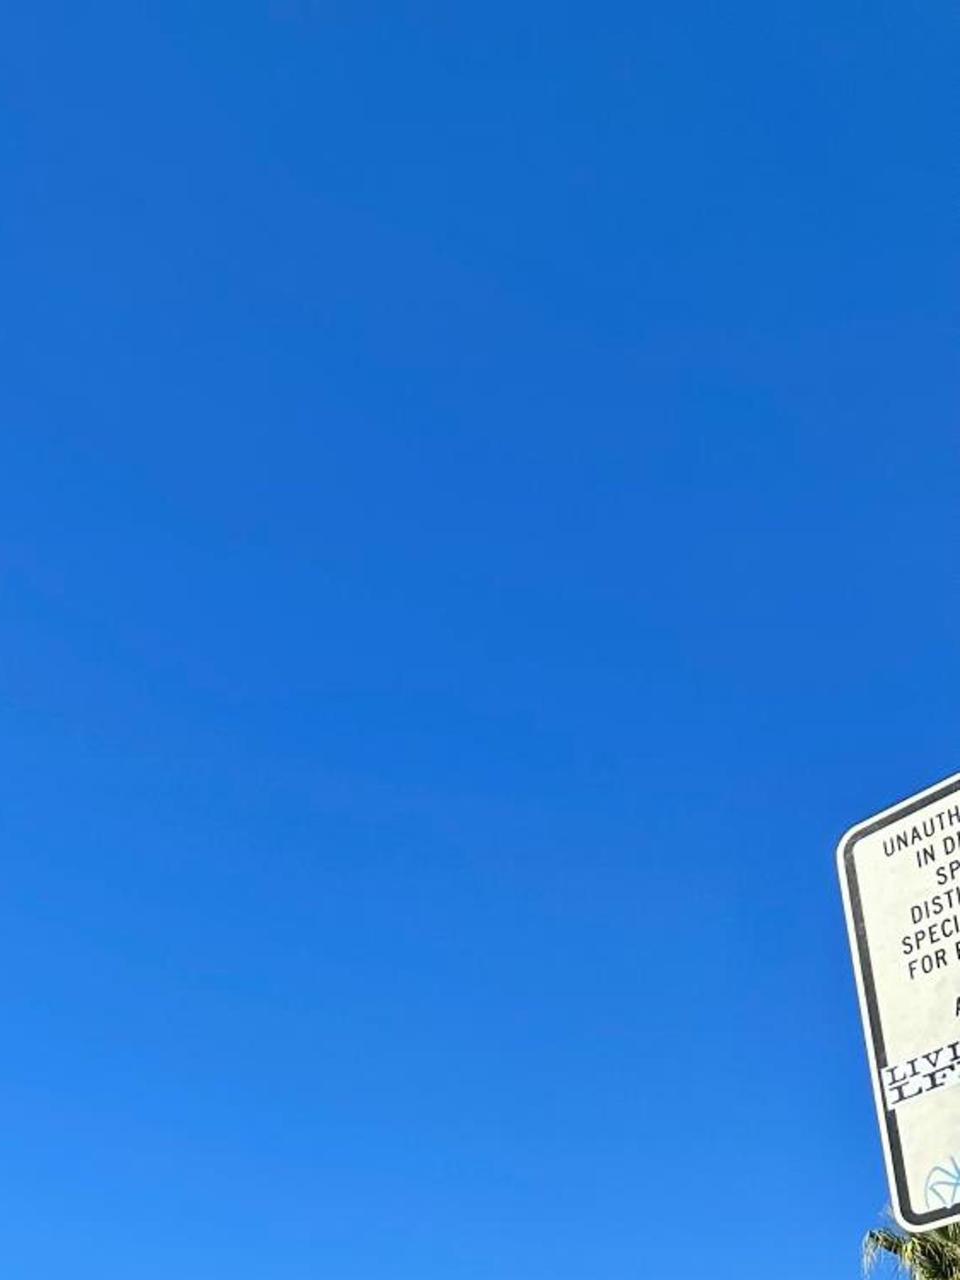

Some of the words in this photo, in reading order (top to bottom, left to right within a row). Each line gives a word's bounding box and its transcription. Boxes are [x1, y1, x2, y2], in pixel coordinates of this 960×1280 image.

[917, 844, 935, 868] IN
[902, 915, 960, 955] SPECI
[908, 949, 948, 980] FOR
